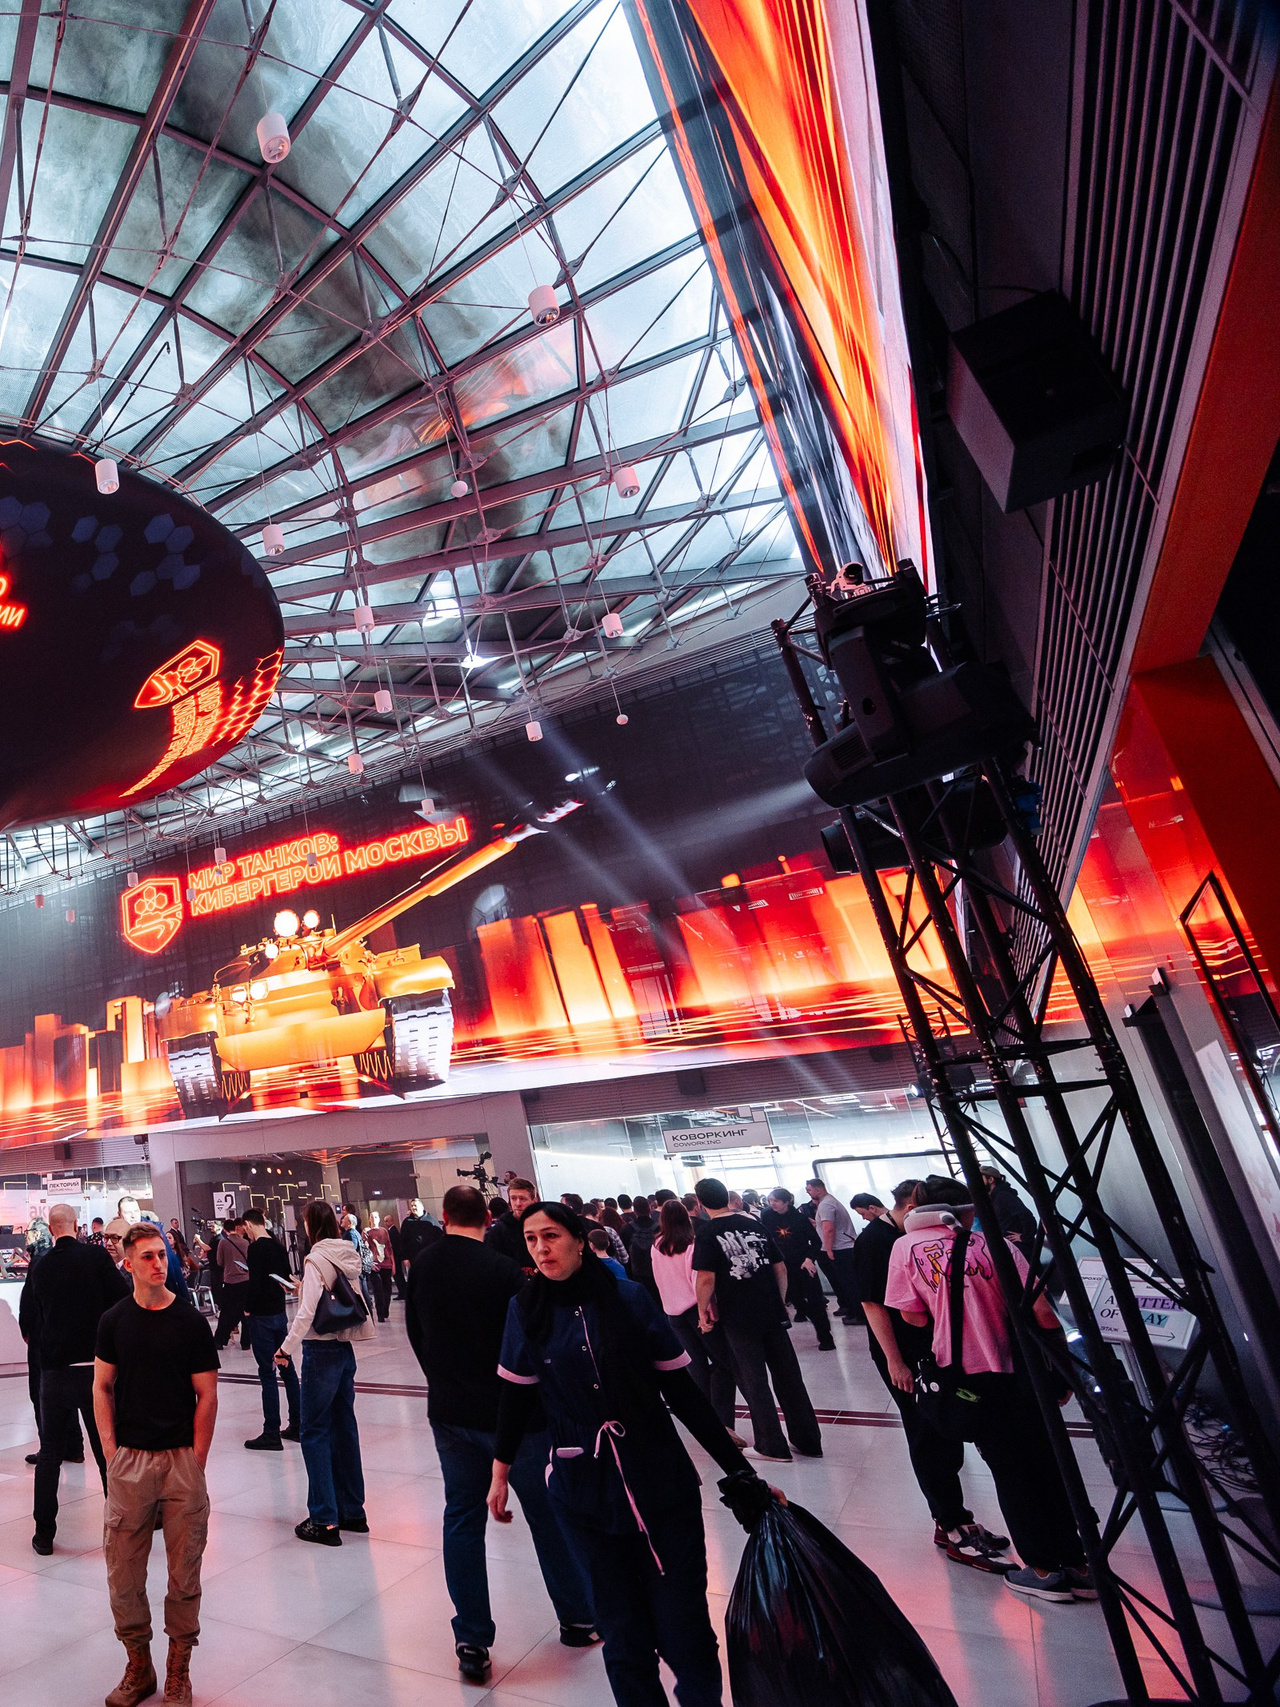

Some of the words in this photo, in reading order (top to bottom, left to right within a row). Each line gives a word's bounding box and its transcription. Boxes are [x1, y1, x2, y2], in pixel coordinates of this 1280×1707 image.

[188, 862, 235, 890] МИР
[237, 833, 339, 877] ТАНКОВ:
[190, 854, 341, 917] КИБЕРГЕРОИ
[344, 817, 468, 874] МОСКВЫ
[671, 1129, 748, 1142] КОВОРКИНГ
[673, 1140, 721, 1148] COWORKING
[49, 1180, 79, 1189] ЛЕКТОРИЙ
[29, 1205, 50, 1219] ак
[1104, 1295, 1114, 1305] A
[1136, 1297, 1183, 1311] TTER
[1100, 1308, 1119, 1319] OF
[1144, 1313, 1168, 1326] AY
